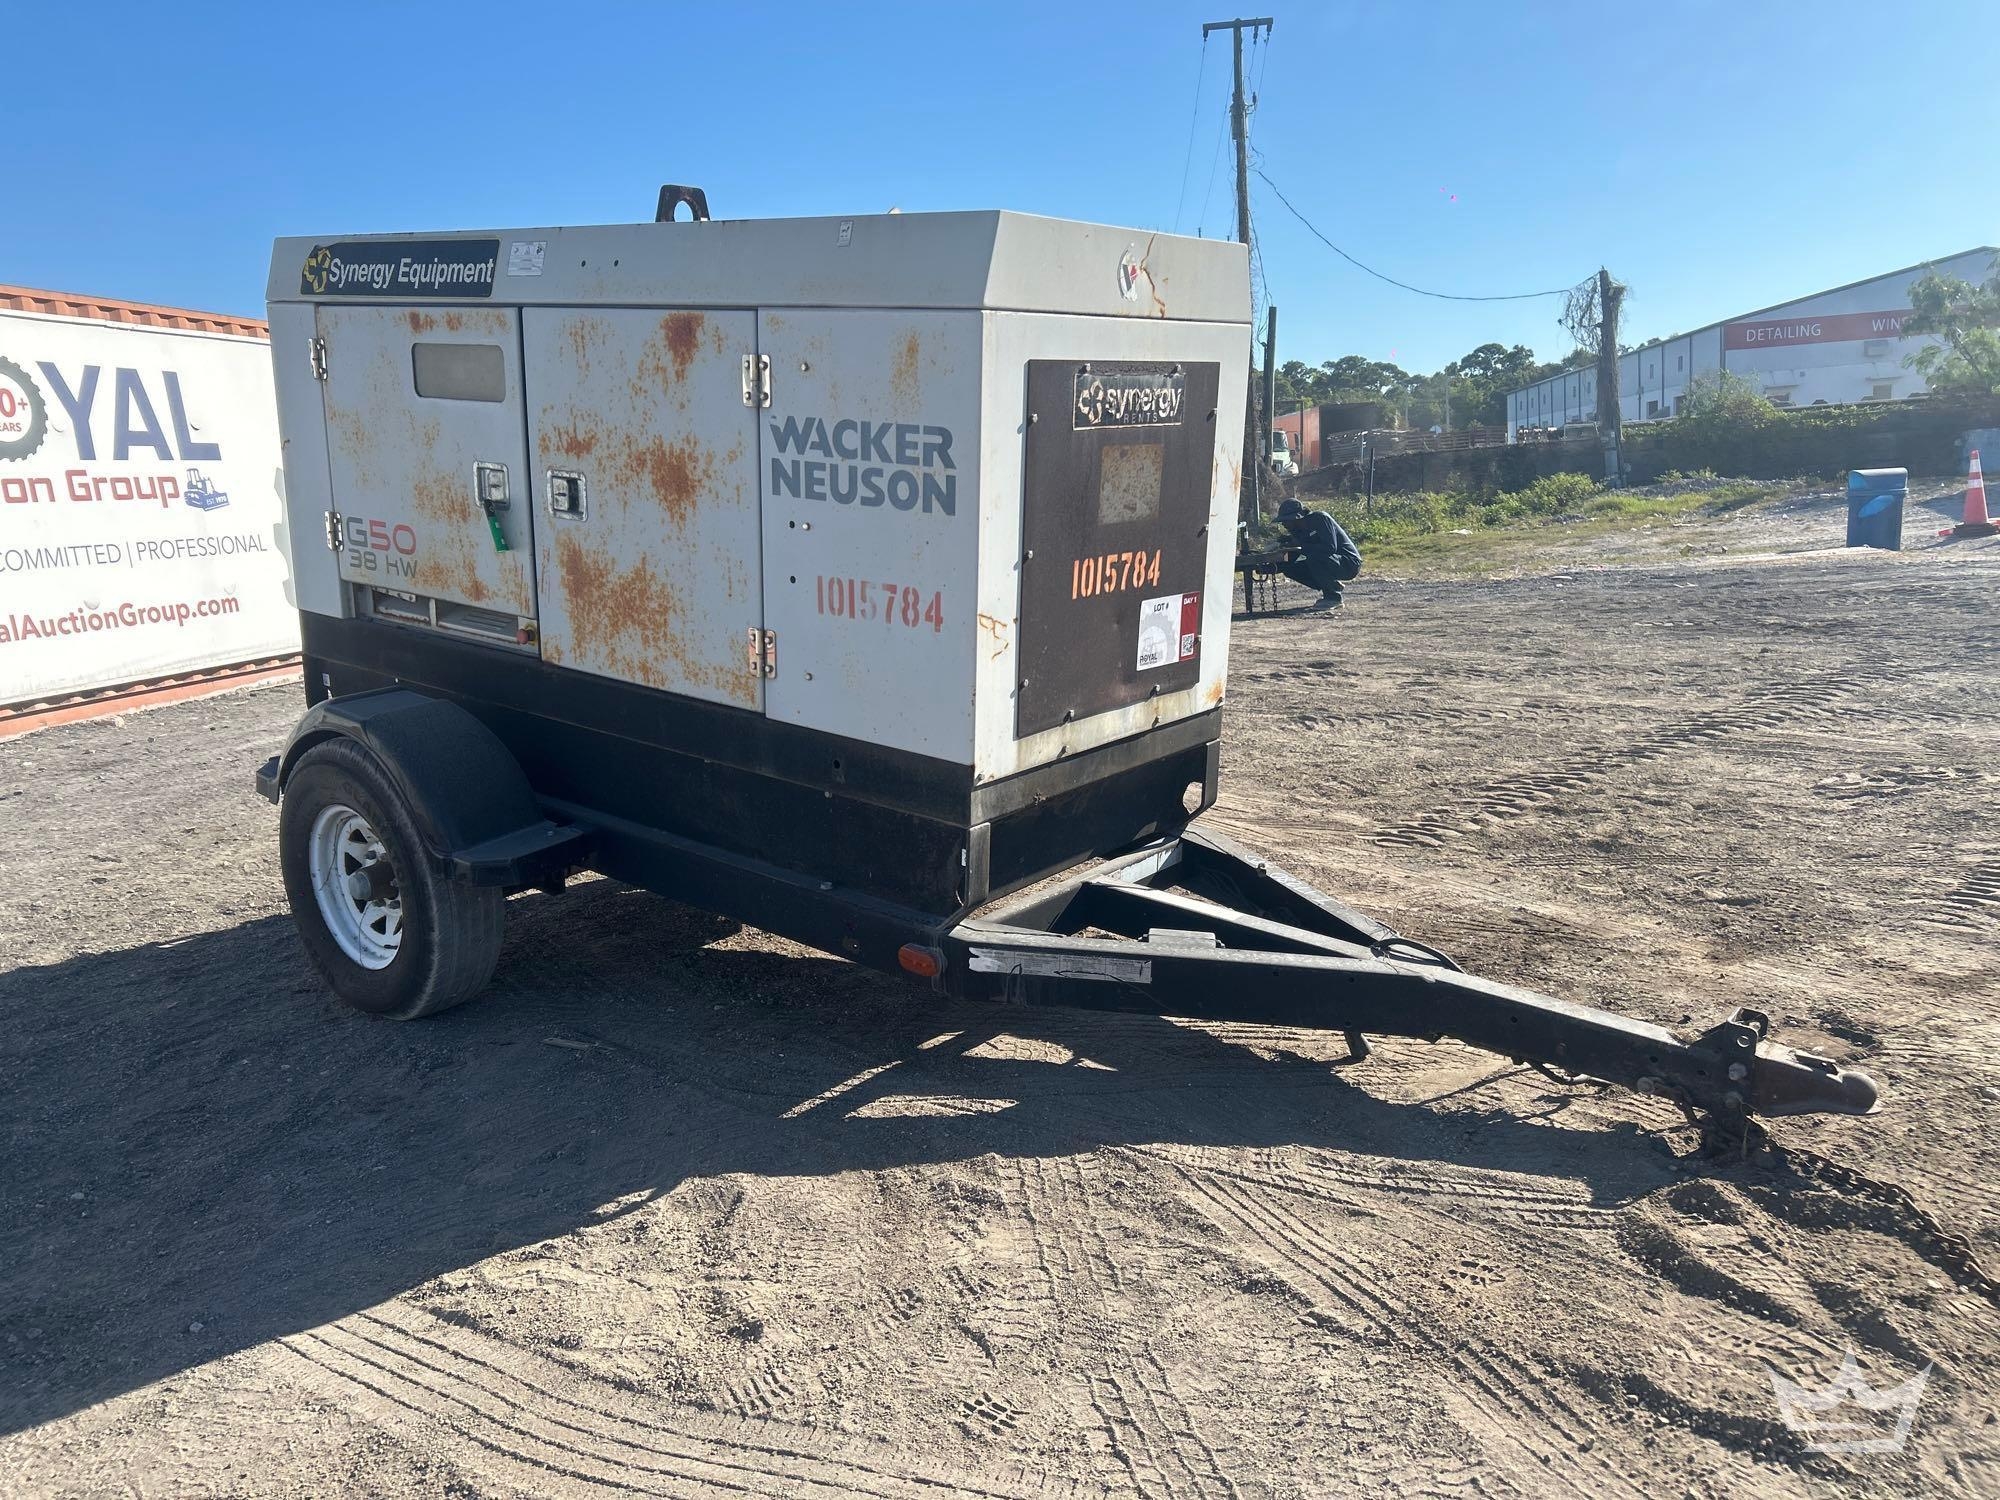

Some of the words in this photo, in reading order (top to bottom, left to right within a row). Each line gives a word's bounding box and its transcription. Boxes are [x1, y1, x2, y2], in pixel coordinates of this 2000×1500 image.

[329, 257, 395, 288] Synergy
[397, 258, 494, 289] Equipment
[1746, 323, 1821, 342] DETAILING
[1105, 388, 1183, 419] synergy
[1123, 412, 1158, 425] RENTS
[0, 422, 22, 433] ARS
[769, 415, 957, 470] WACKER
[65, 469, 180, 508] Group
[771, 457, 957, 517] NEUSON
[136, 534, 268, 561] PROFESSIONAL
[346, 516, 417, 556] G50
[348, 548, 377, 572] 38
[1072, 549, 1161, 600] 1015784
[817, 575, 944, 633] 1015784
[1153, 603, 1165, 612] LOT
